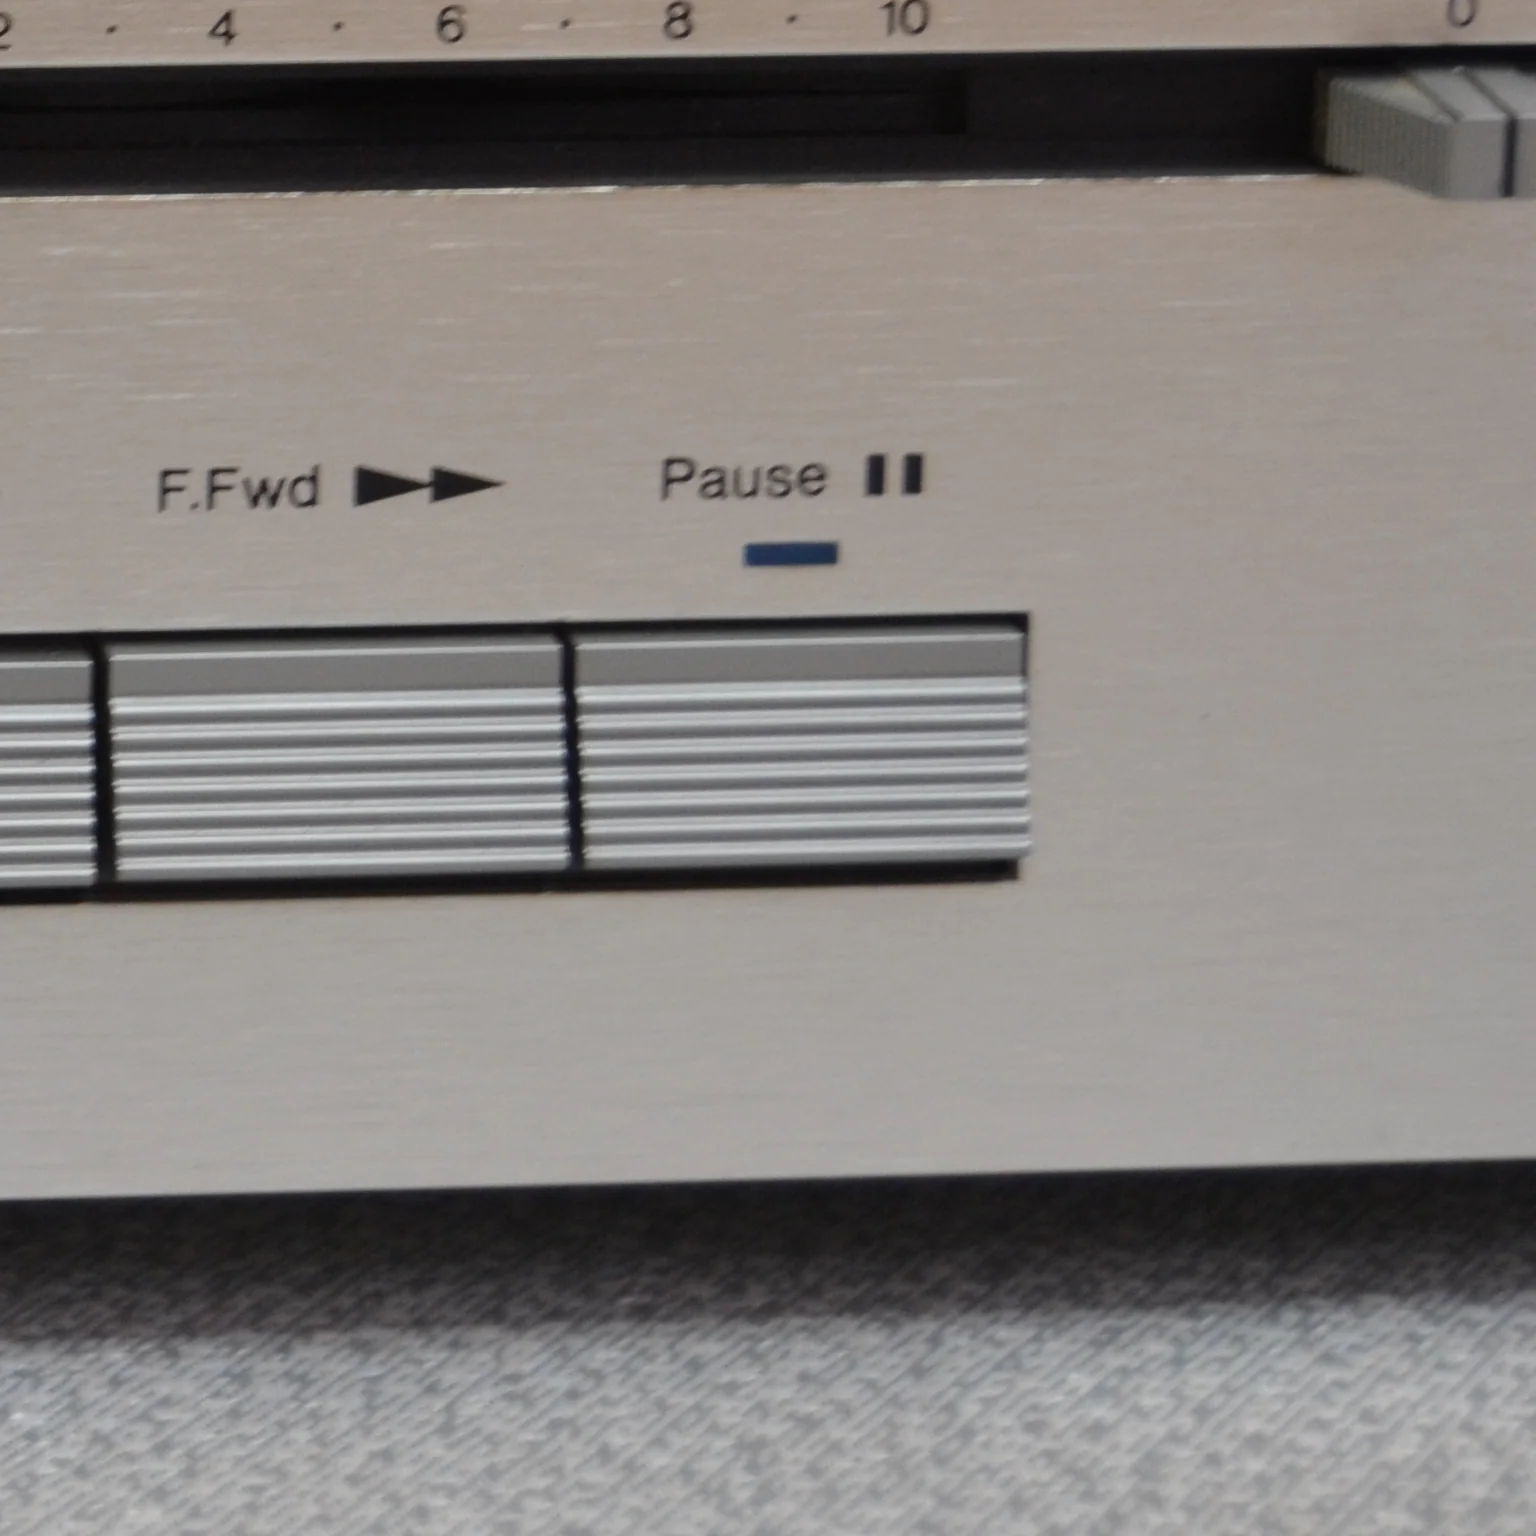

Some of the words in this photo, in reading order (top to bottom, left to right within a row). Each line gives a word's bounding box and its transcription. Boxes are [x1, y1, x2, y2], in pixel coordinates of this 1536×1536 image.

[209, 10, 236, 45] 4
[436, 5, 465, 44] 6
[663, 0, 694, 40] 8
[159, 466, 320, 511] F.Fwd
[662, 456, 828, 500] Pause
